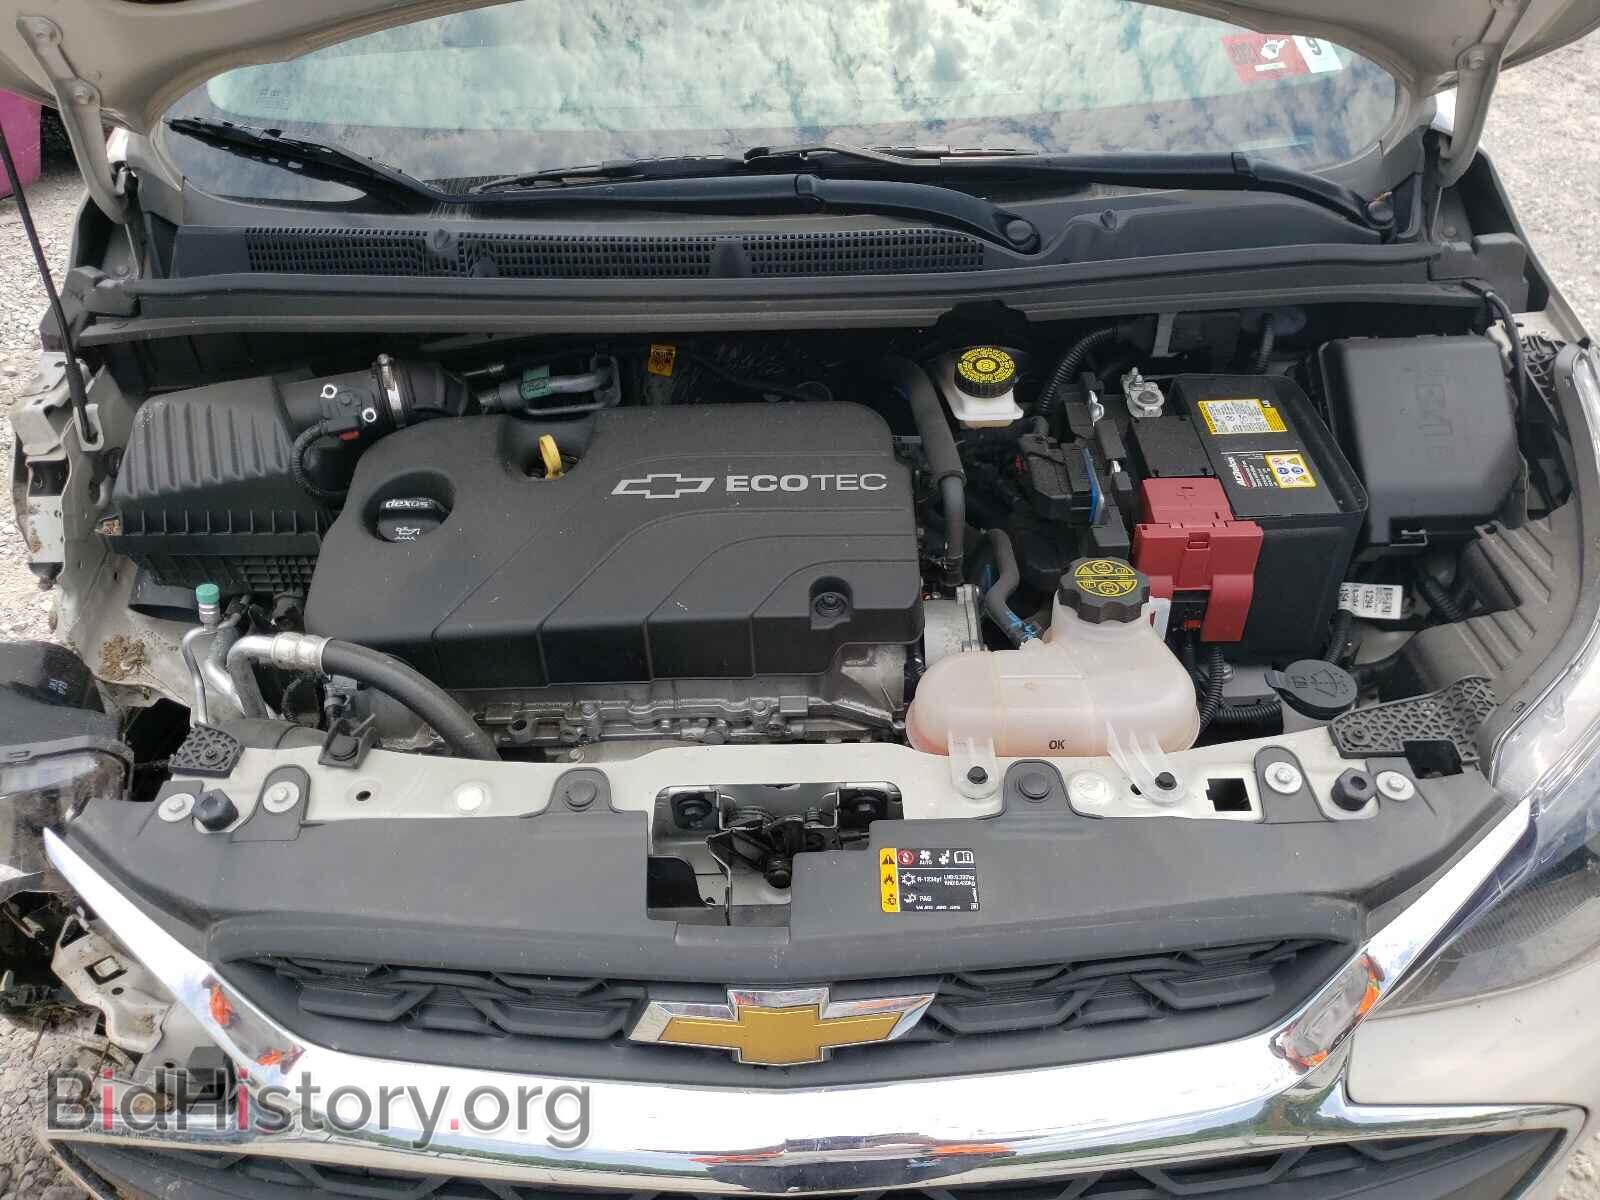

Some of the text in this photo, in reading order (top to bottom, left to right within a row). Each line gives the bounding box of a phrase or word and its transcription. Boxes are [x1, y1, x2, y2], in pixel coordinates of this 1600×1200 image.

[726, 473, 888, 492] ECOTEC
[385, 499, 429, 509] dexos
[1048, 739, 1065, 750] OK
